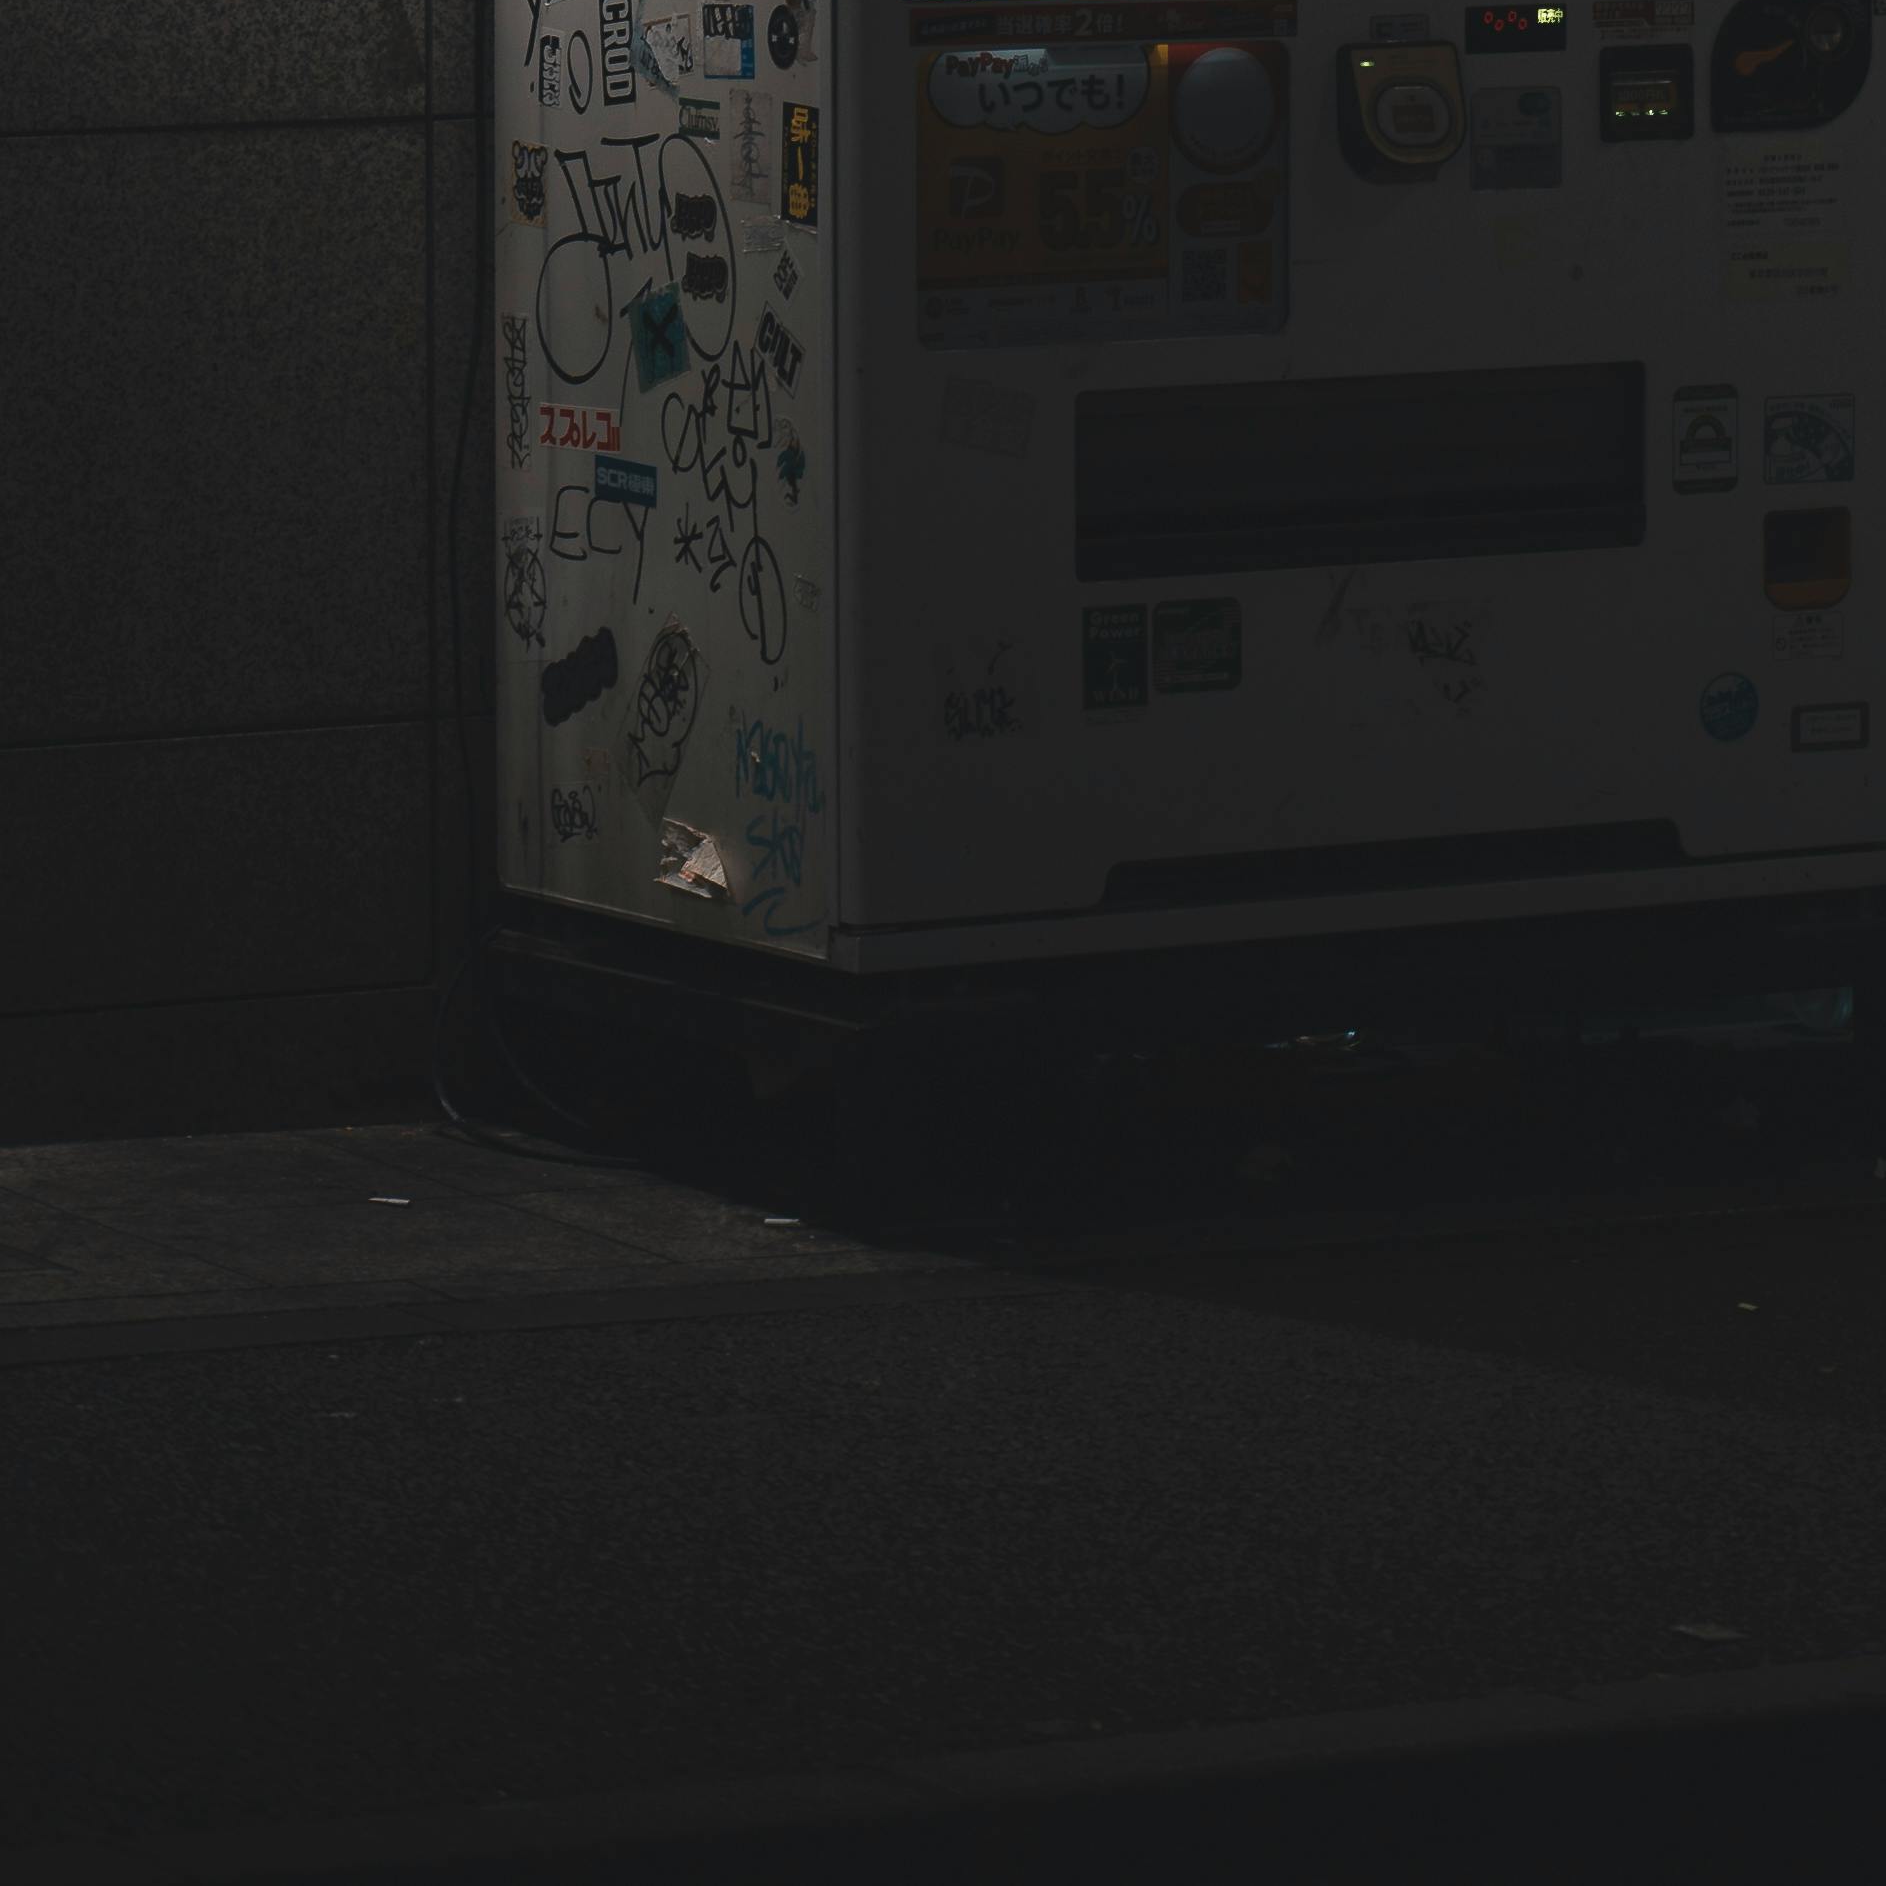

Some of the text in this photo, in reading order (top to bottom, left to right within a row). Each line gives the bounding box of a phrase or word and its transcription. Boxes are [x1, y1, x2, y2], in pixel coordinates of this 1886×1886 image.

[977, 73, 1127, 113] いつでも!
[930, 226, 1021, 254] PayPay
[1088, 610, 1142, 628] Green
[1088, 627, 1143, 641] Power
